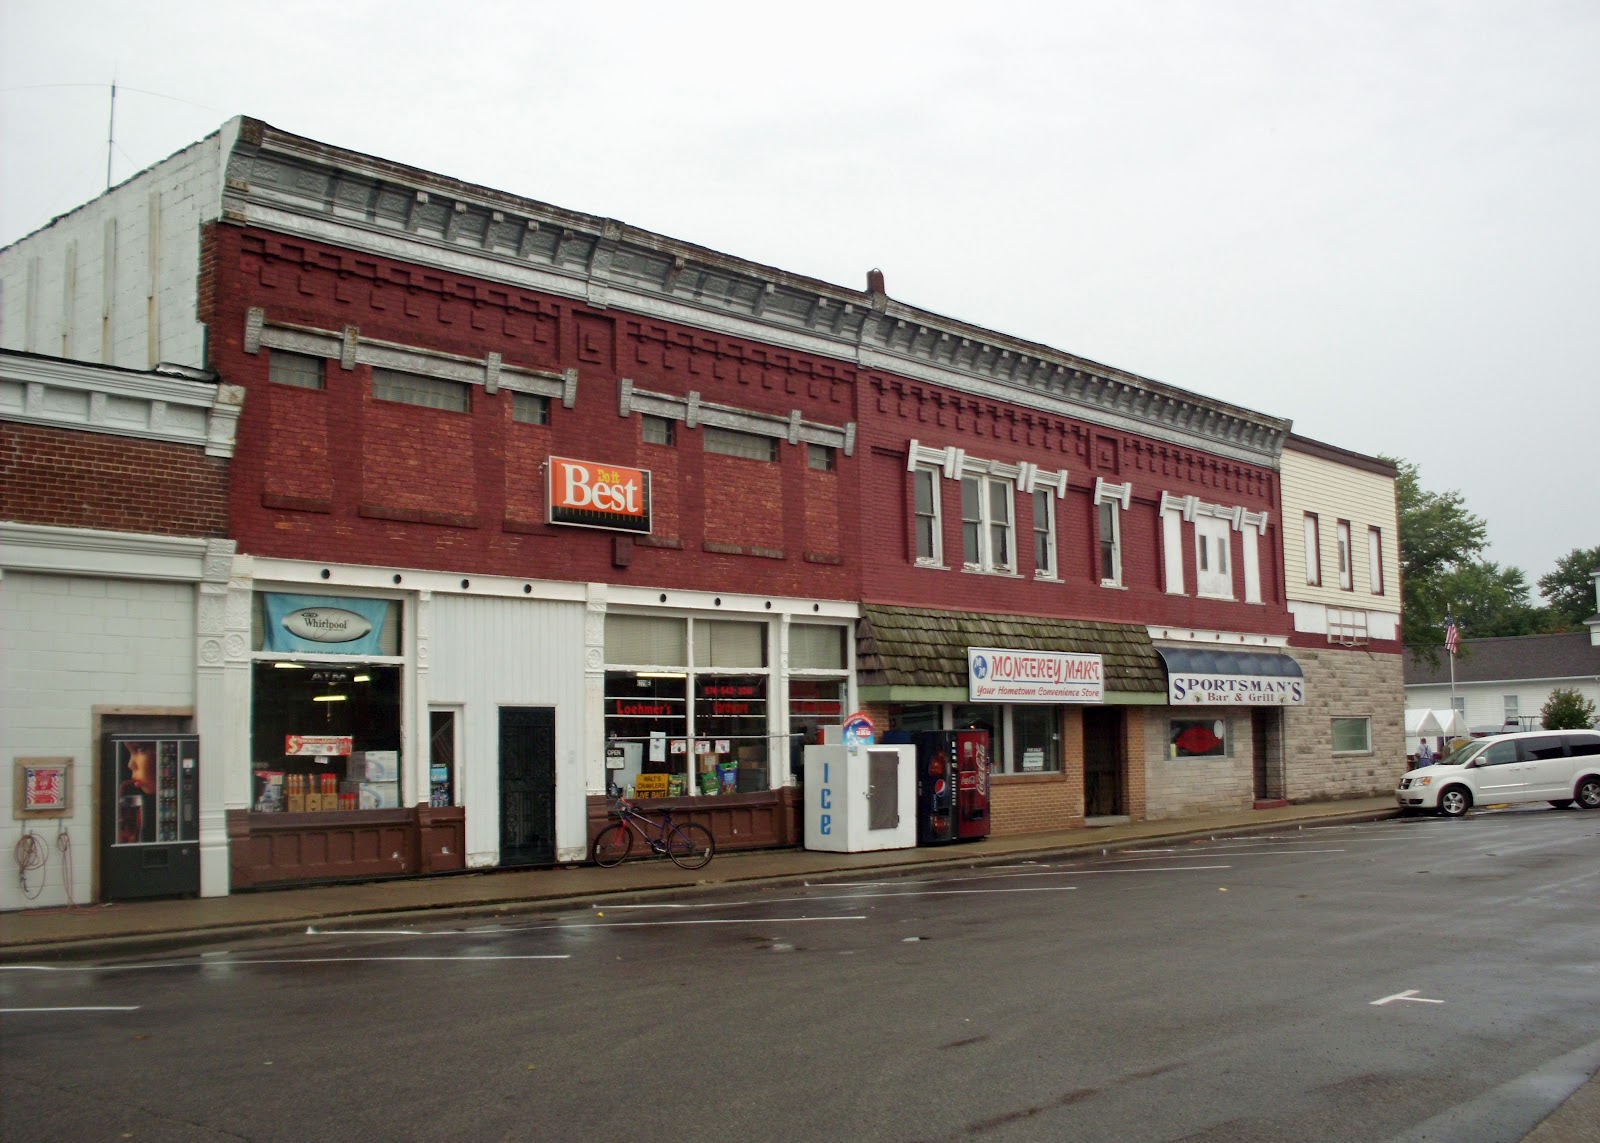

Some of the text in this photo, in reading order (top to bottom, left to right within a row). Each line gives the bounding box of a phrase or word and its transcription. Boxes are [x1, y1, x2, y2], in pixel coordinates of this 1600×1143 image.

[597, 468, 620, 484] Do it
[561, 463, 639, 513] Best
[304, 617, 347, 630] Whirlpool
[311, 671, 347, 681] ATM
[991, 656, 1100, 684] MONTEREY MART
[977, 685, 1100, 697] Your Hometown Convenience Store
[1174, 678, 1302, 702] SPORTSMAN'S
[1207, 692, 1275, 702] Bar & Grill
[616, 699, 672, 715] Loehmer's
